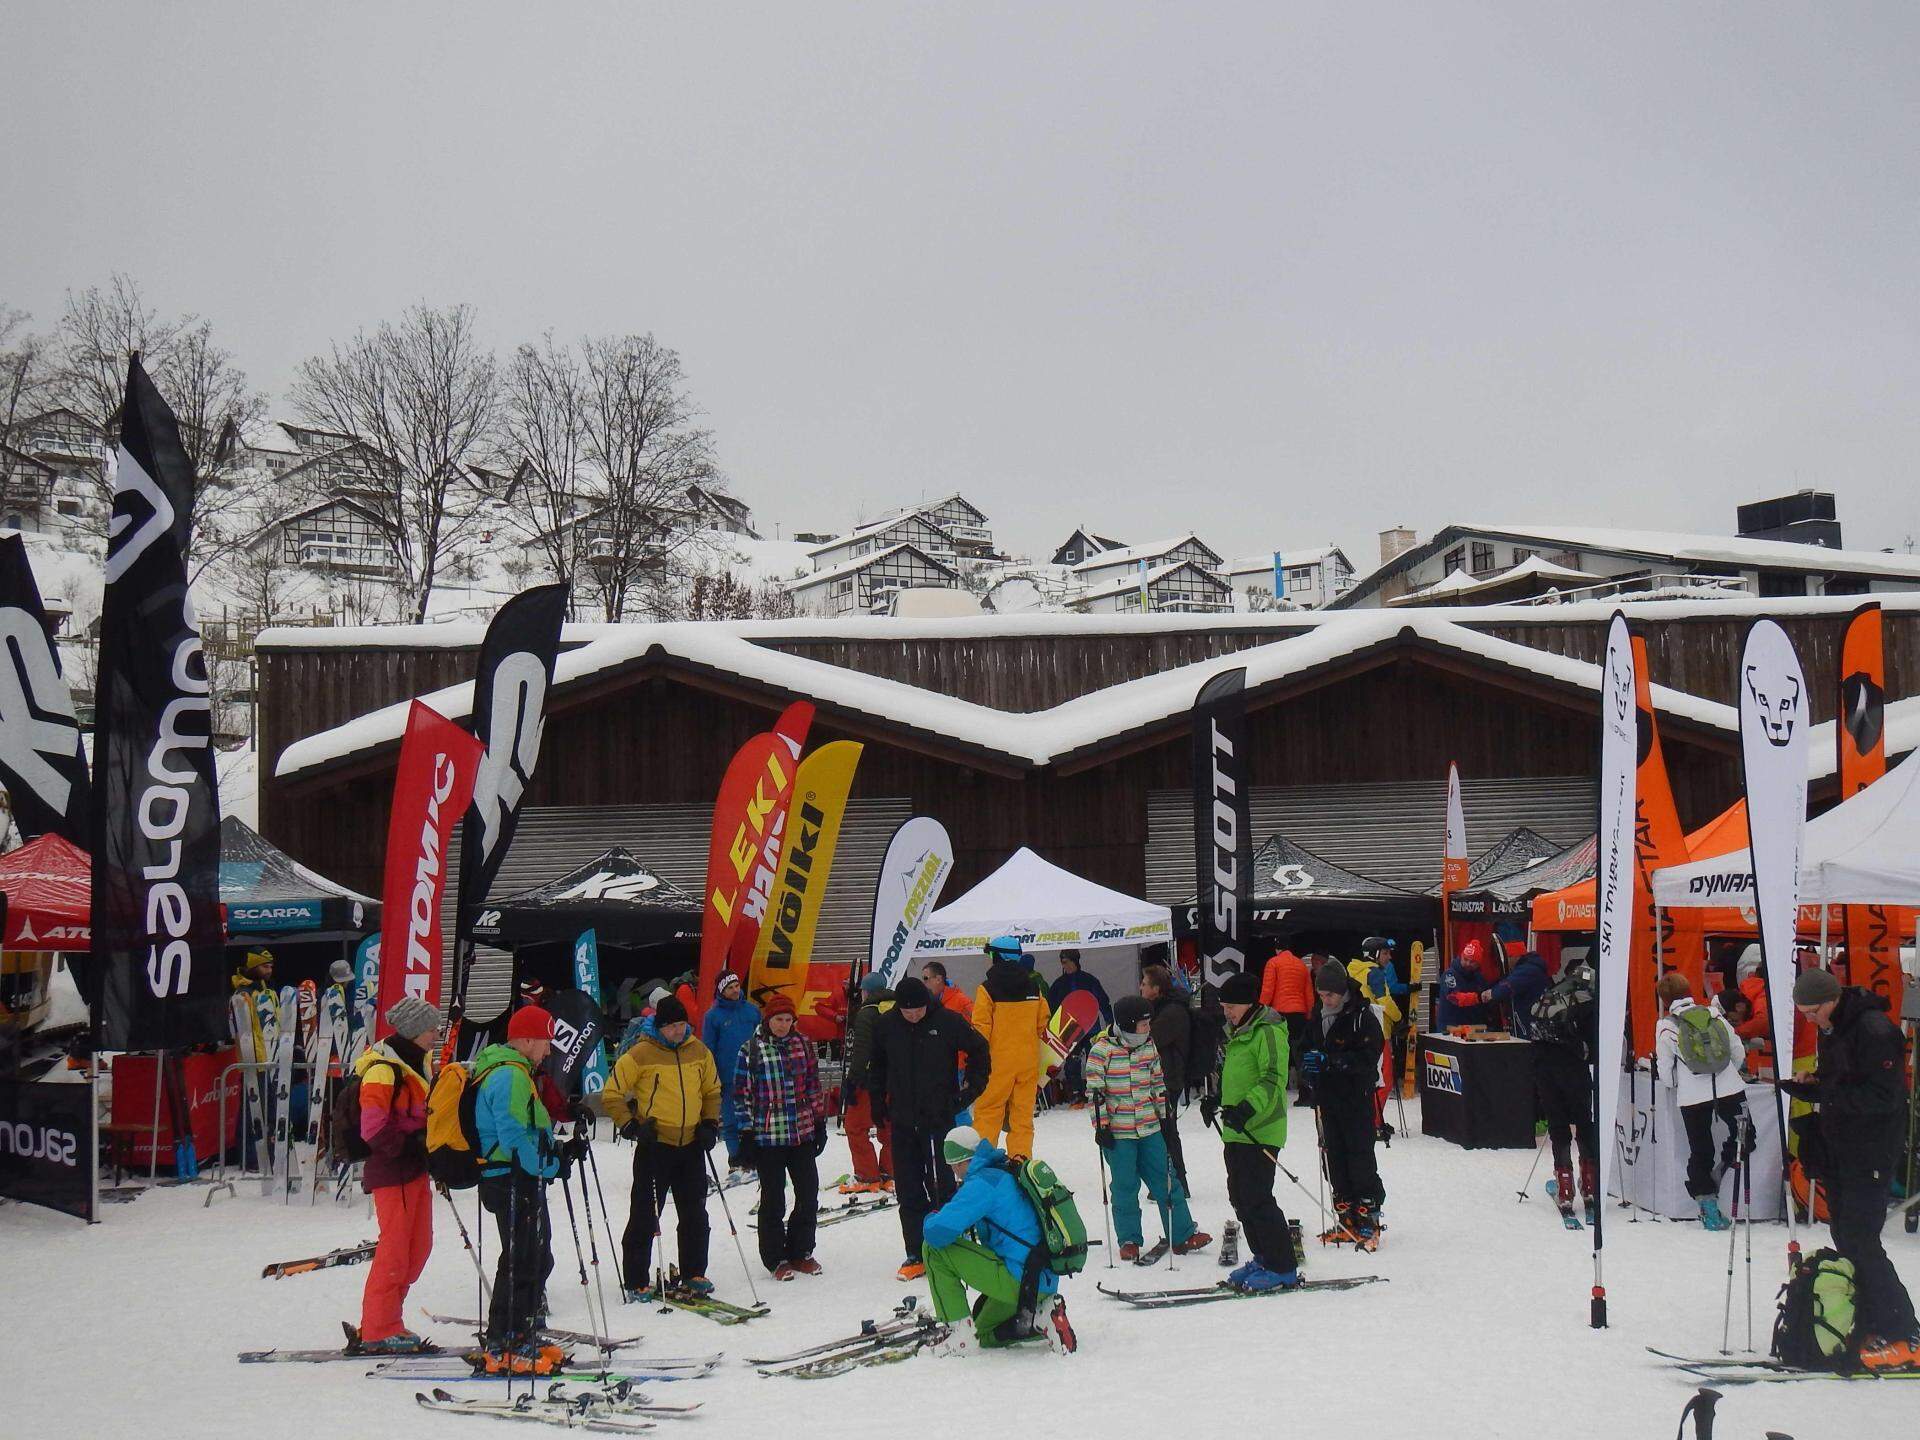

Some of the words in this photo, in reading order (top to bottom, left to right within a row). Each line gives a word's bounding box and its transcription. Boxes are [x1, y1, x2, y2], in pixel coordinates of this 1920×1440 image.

[711, 752, 788, 927] LEKI
[1211, 716, 1237, 941] SCOTT
[404, 752, 455, 1001] ATOMIC
[555, 872, 660, 900] K2
[233, 907, 311, 919] SCARPA
[475, 910, 501, 927] K2
[1492, 900, 1525, 914] LANGE
[1087, 927, 1126, 940] SPORT
[1601, 921, 1612, 956] SKI
[562, 1021, 596, 1074] salomon
[1427, 1067, 1454, 1091] LOOK
